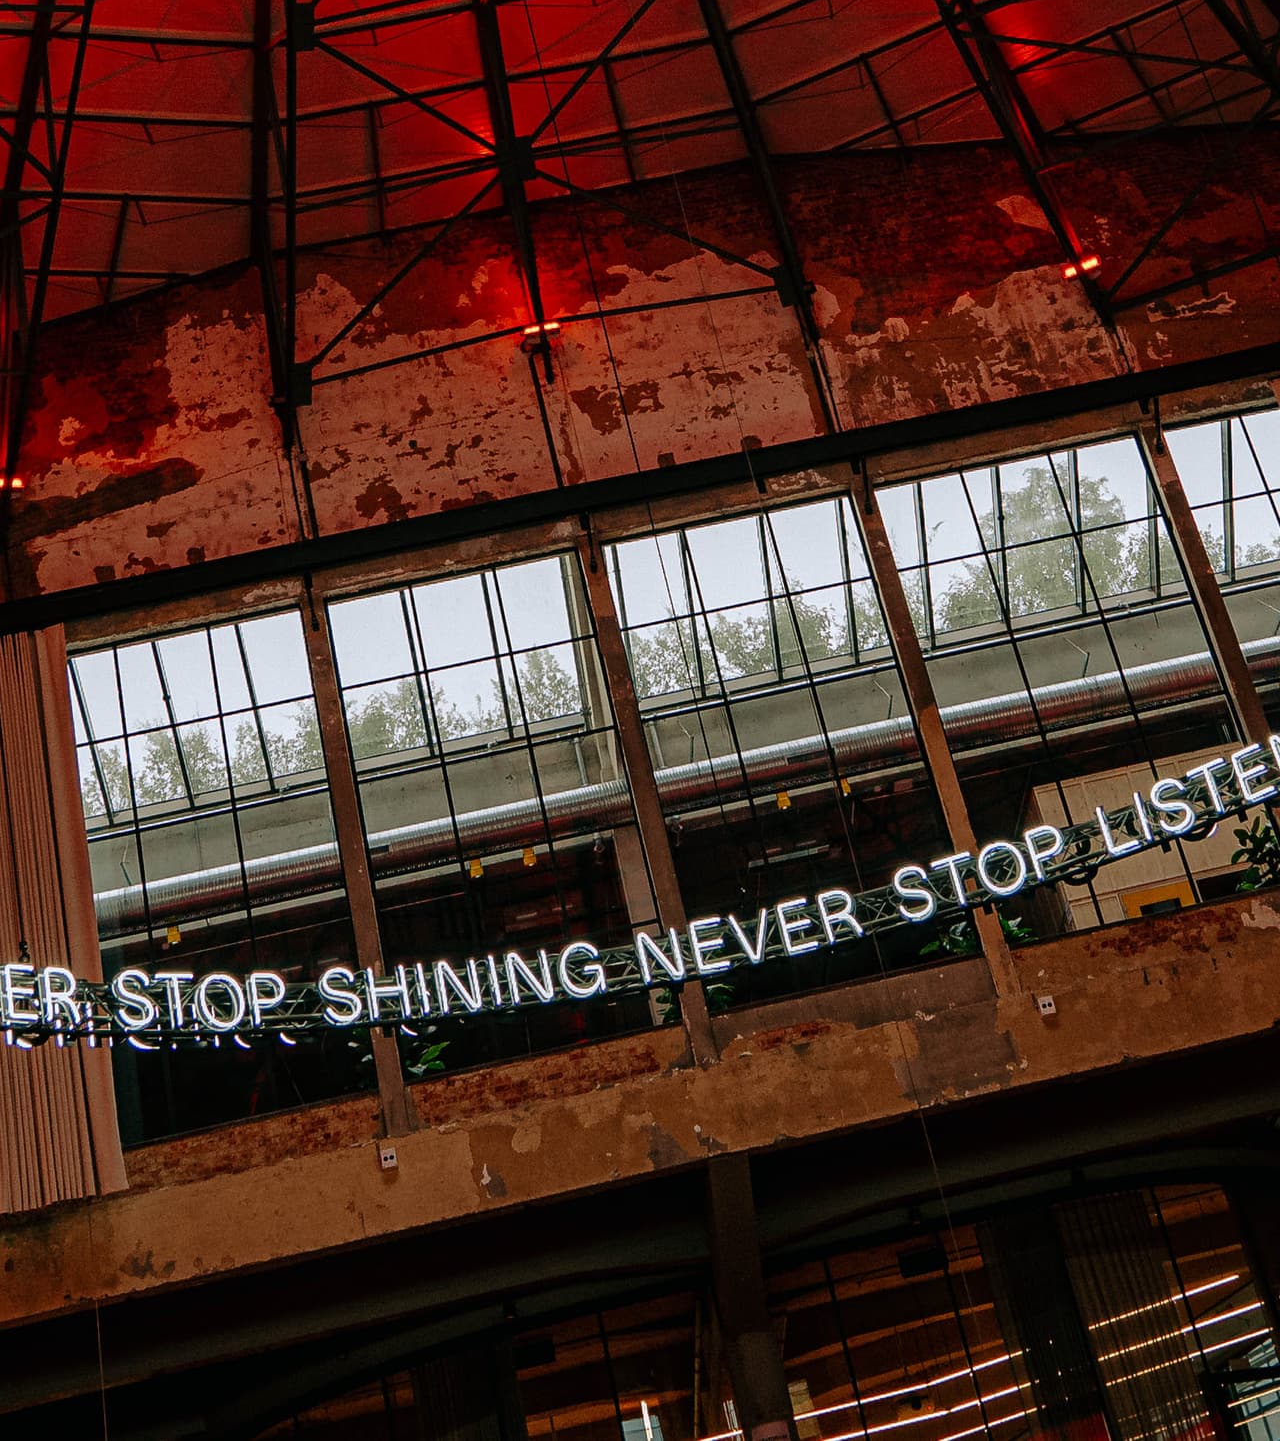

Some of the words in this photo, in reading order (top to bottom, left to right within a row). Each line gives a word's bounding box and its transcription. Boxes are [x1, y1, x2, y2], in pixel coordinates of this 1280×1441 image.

[112, 968, 287, 1030] STOP
[319, 941, 608, 1027] SHINING
[635, 888, 865, 985] NEVER
[893, 824, 1065, 923] STOP
